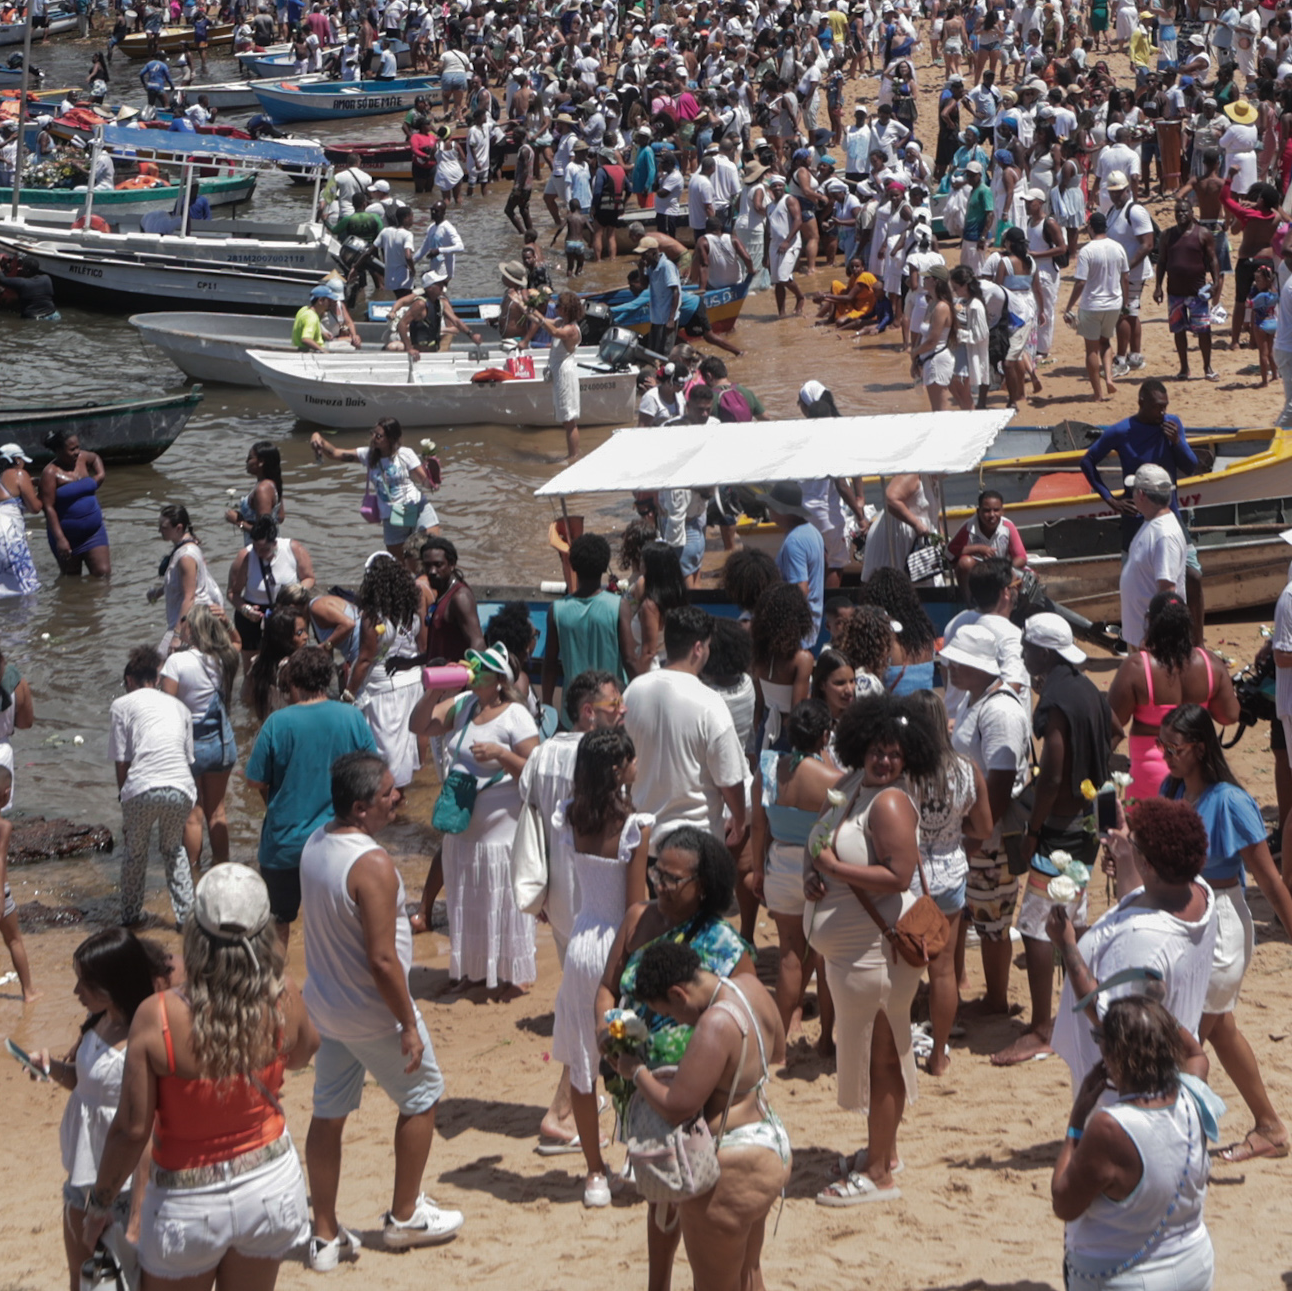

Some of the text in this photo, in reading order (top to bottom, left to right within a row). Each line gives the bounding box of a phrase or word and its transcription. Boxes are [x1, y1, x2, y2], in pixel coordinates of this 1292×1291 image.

[333, 99, 355, 110] AMOR
[357, 96, 367, 109] SÓ
[368, 97, 379, 108] DE
[69, 265, 103, 278] ATLÉTICO
[580, 381, 617, 391] 24000638
[304, 394, 366, 407] Thereza Dois
